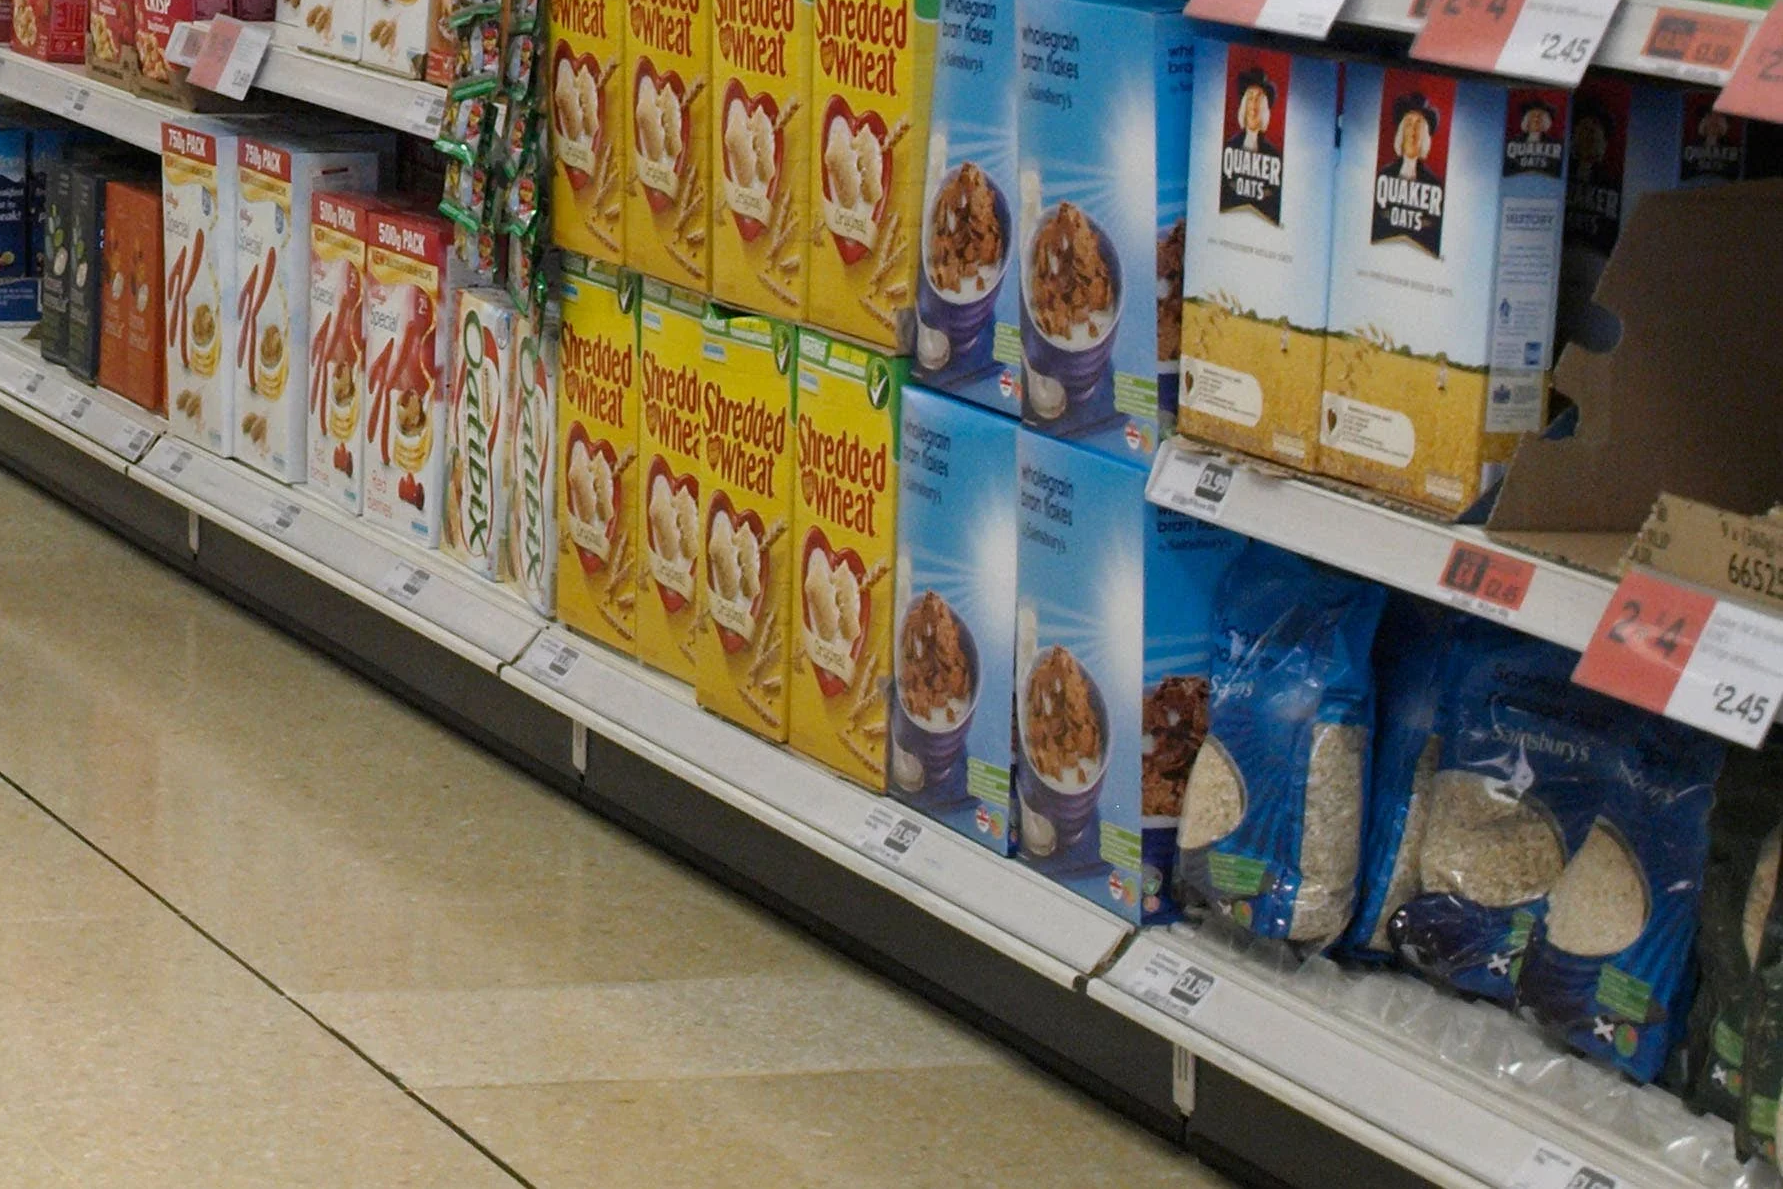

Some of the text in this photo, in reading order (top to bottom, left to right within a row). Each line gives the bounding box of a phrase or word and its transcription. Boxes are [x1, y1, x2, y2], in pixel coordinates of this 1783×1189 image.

[1046, 52, 1080, 80] flakes
[1539, 32, 1591, 66] £2.45
[167, 128, 206, 158] 750g PACK
[262, 147, 281, 174] PACK
[1506, 141, 1563, 161] QUAKER
[1222, 147, 1282, 188] QUAKER
[1235, 179, 1265, 201] OATS
[1376, 174, 1444, 215] QUAKER
[319, 199, 356, 232] 500g PACK
[1389, 206, 1424, 232] OATS
[377, 222, 426, 257] 500g PACK
[561, 320, 632, 389] Shredded
[462, 309, 489, 559] Oatibix
[703, 381, 787, 456] Shredded
[797, 412, 888, 494] Shredded
[1608, 600, 1687, 659] 2 £4
[1712, 681, 1770, 726] £2.45
